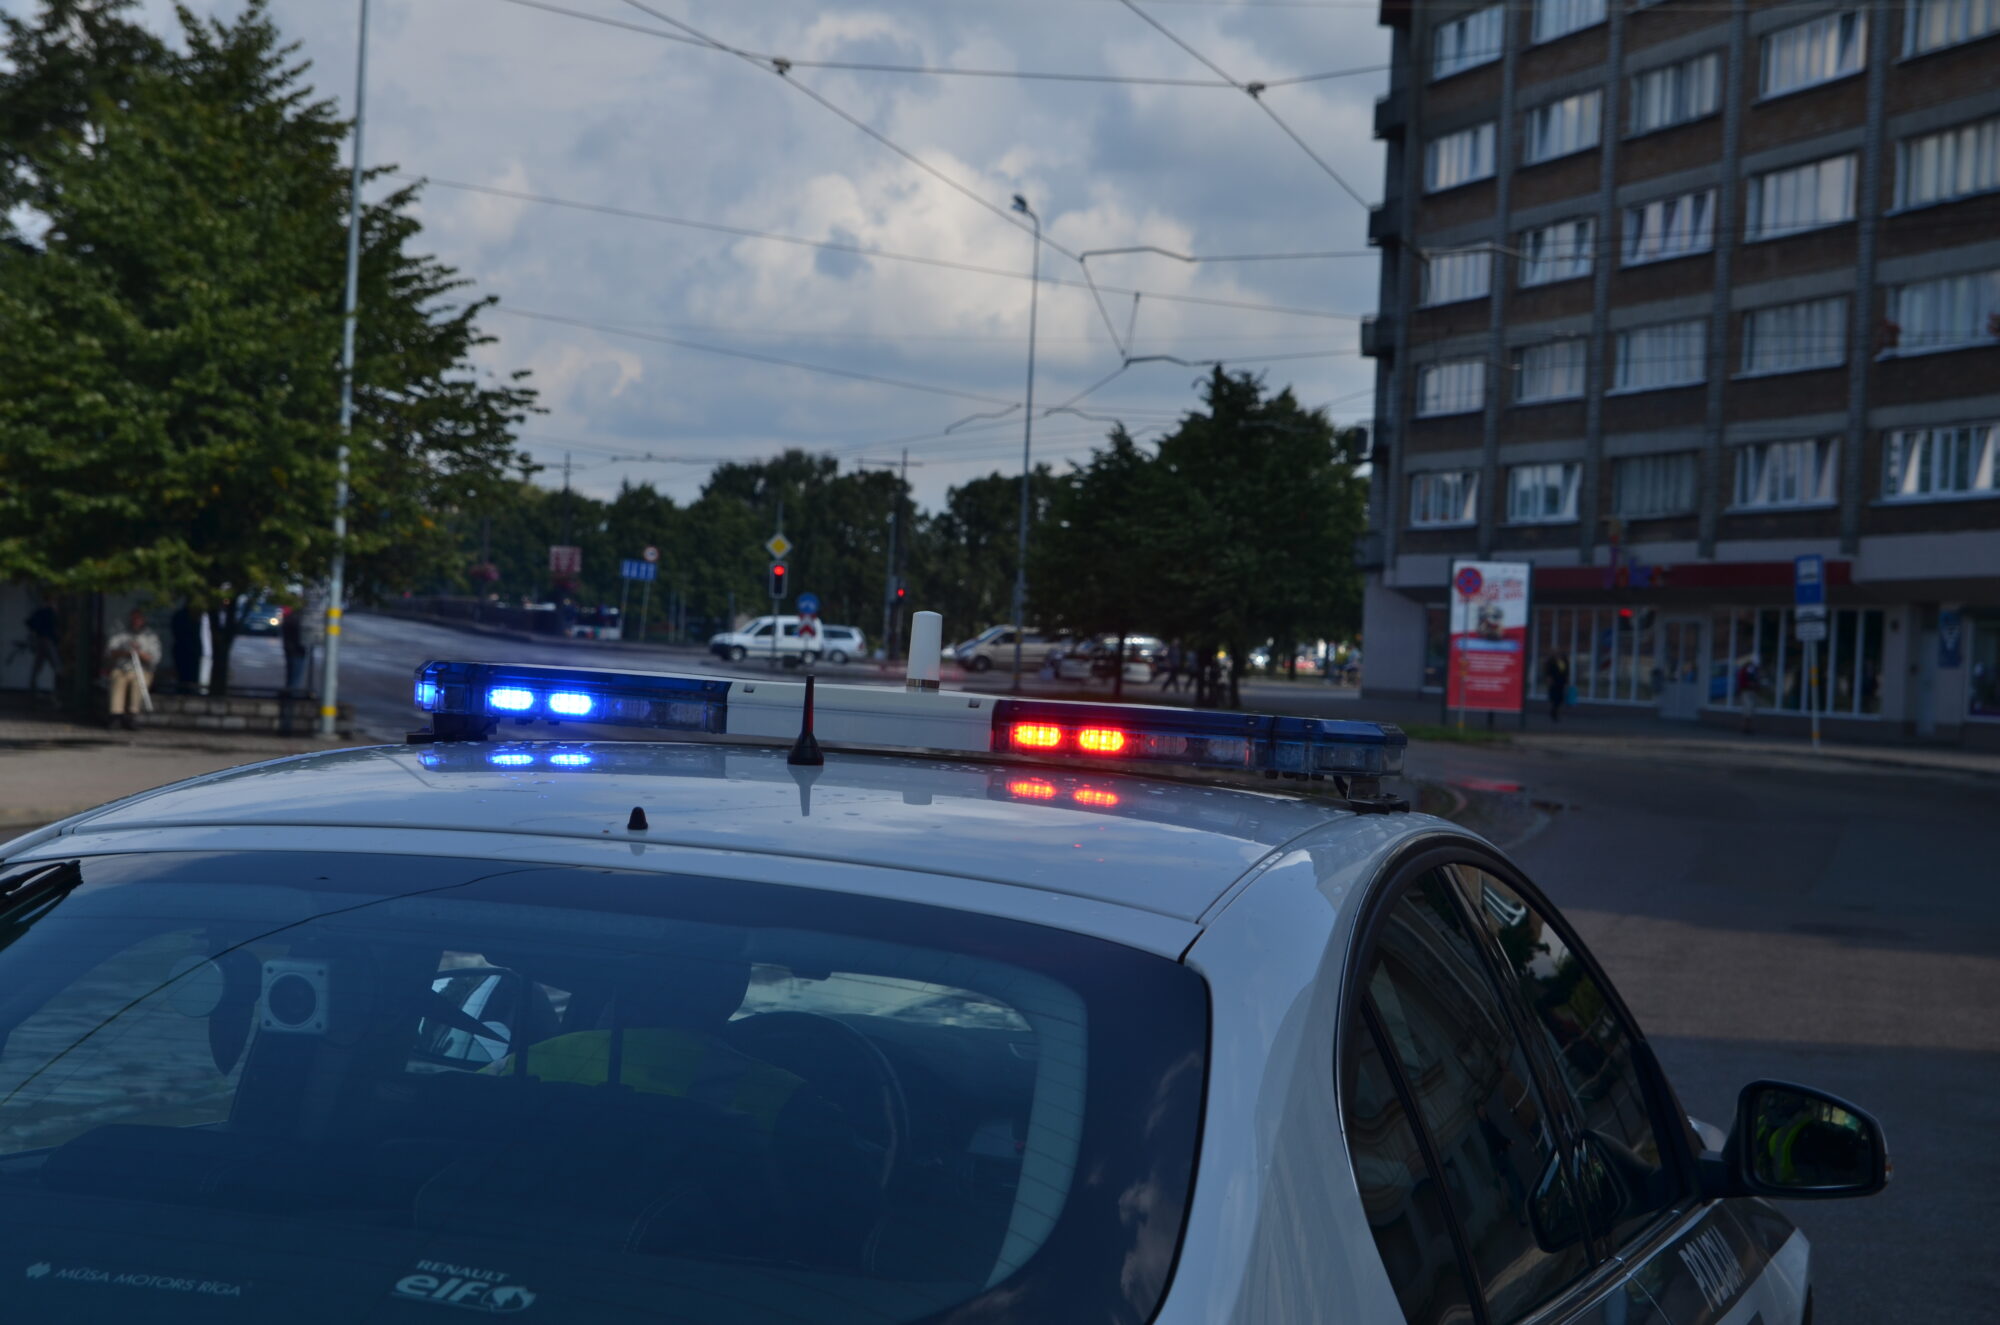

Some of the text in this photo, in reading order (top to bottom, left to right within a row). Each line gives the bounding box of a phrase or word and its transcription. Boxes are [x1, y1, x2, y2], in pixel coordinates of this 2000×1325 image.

[113, 1273, 196, 1291] MOTORS
[416, 1259, 510, 1283] RENAULT
[395, 1274, 490, 1303] elf
